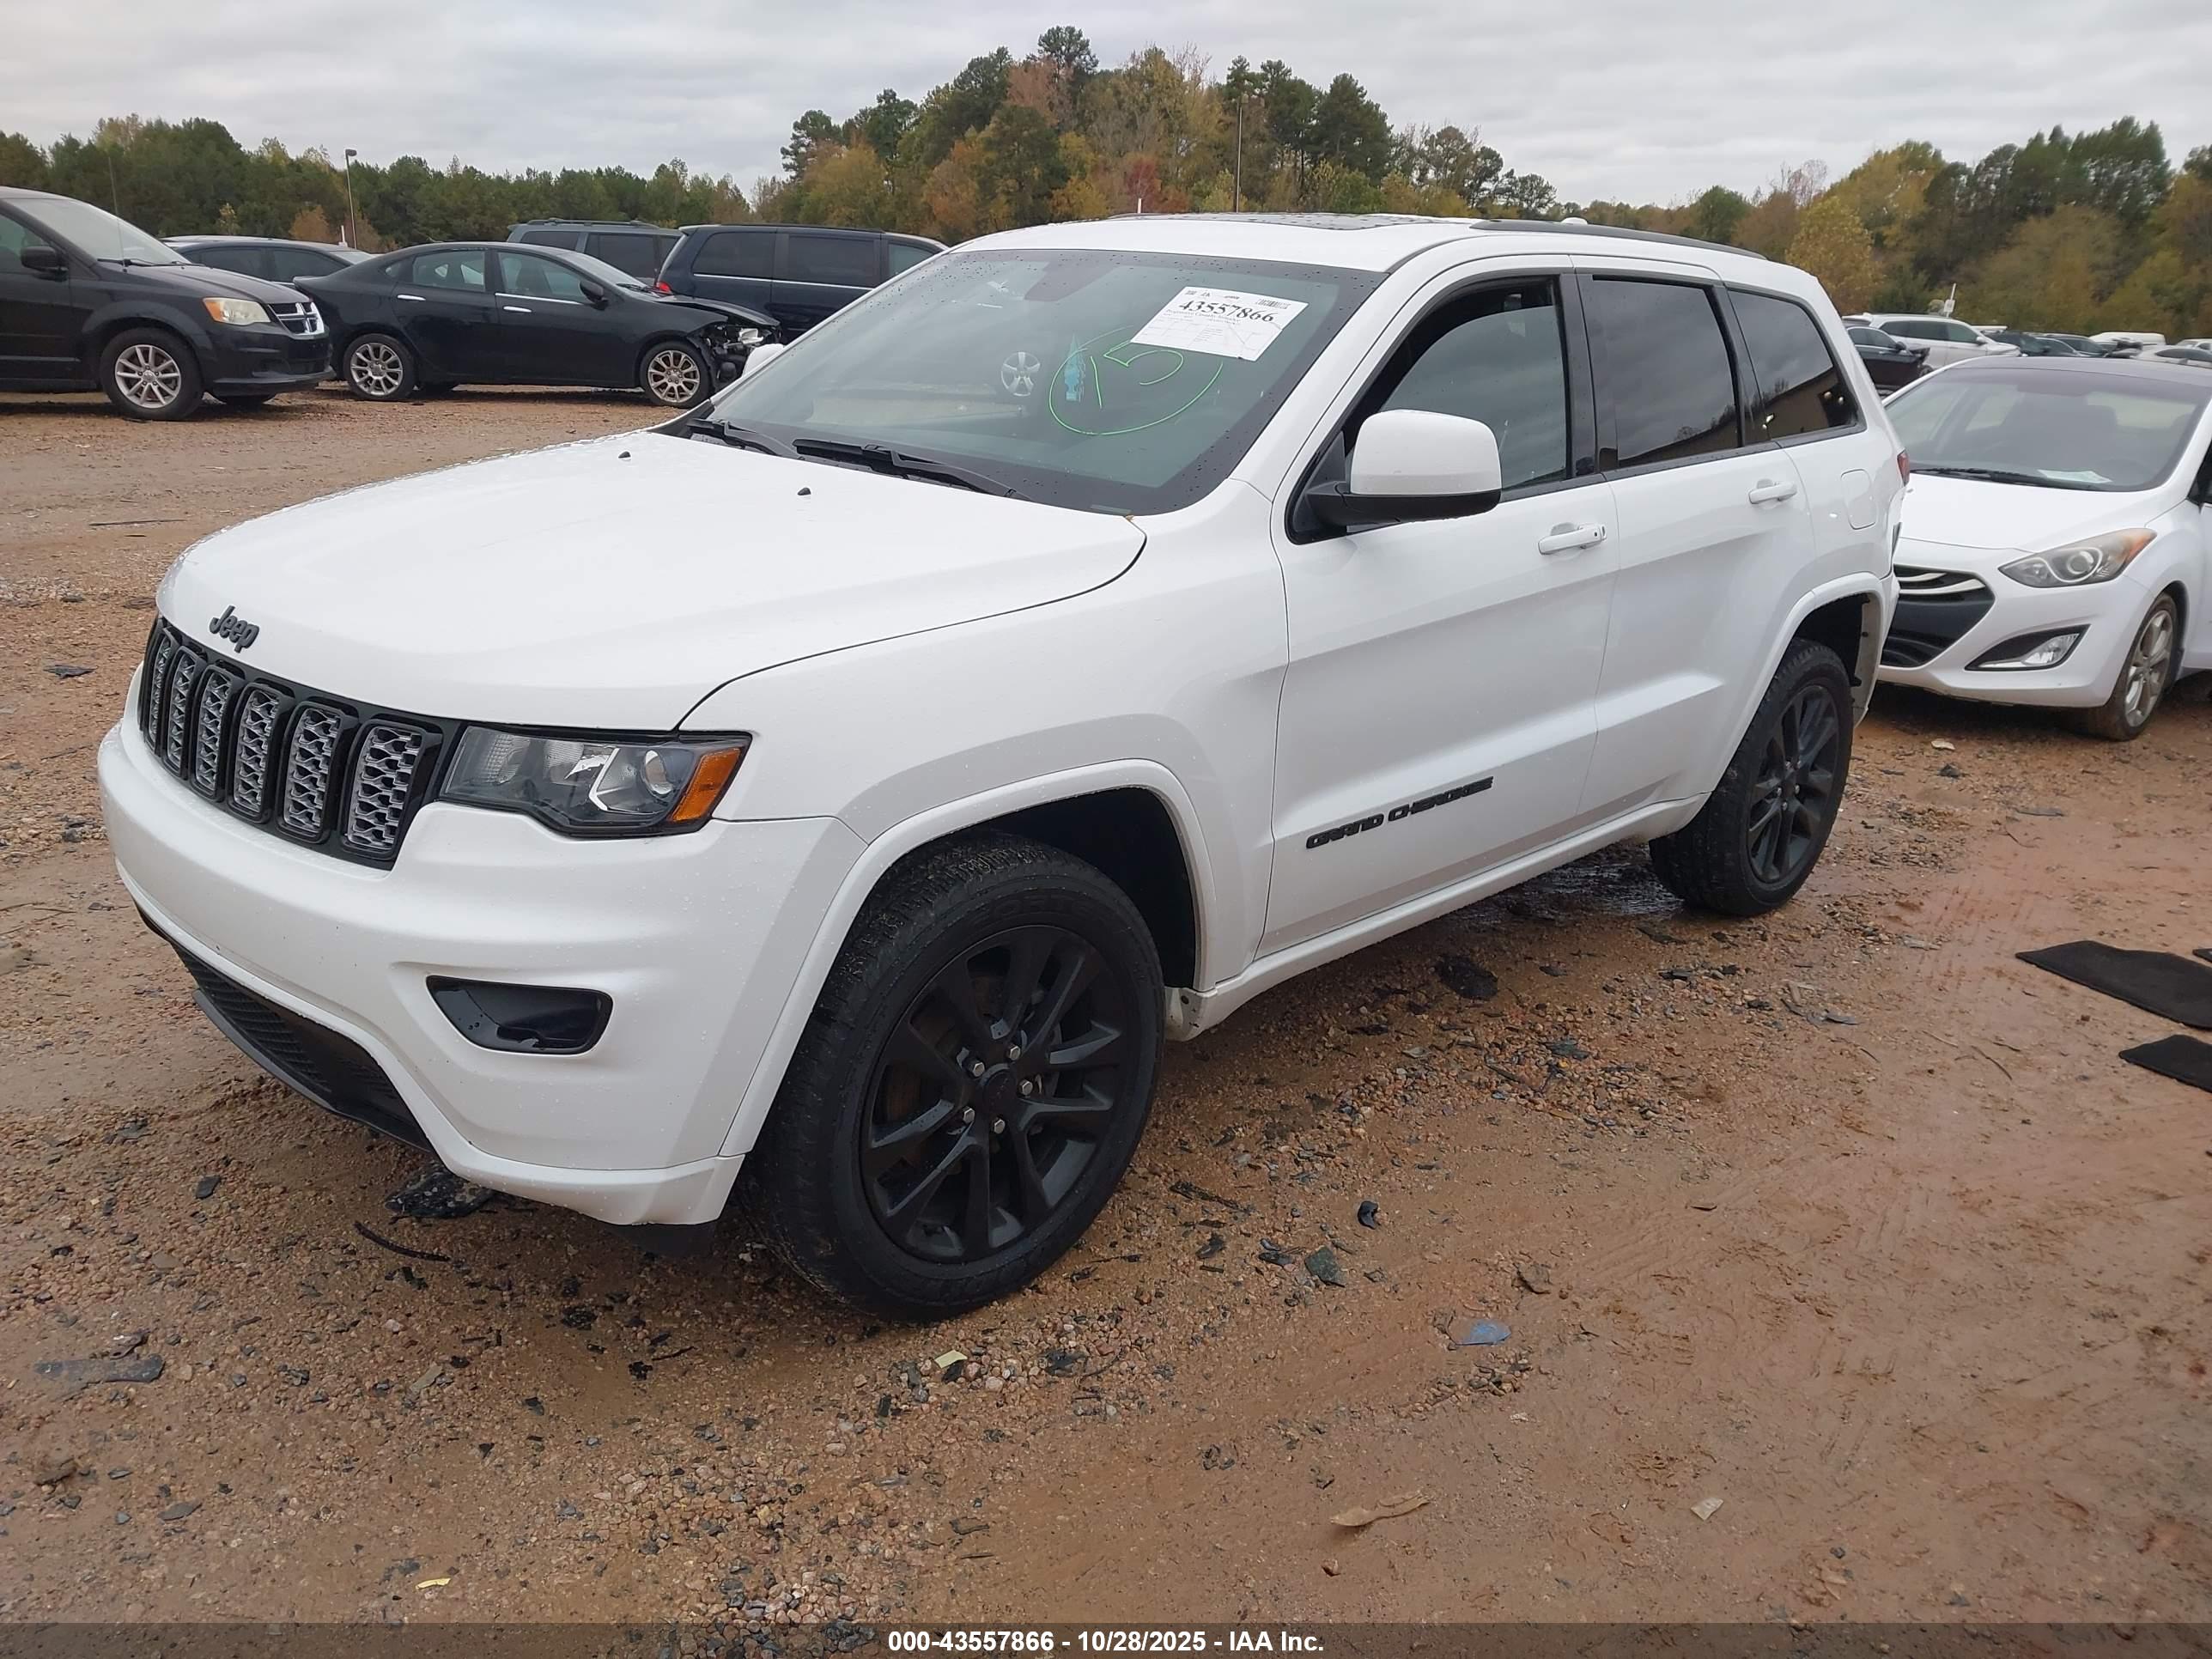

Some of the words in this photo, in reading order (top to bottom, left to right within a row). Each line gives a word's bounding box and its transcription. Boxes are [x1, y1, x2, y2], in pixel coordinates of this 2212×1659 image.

[1179, 300, 1278, 322] 43557866
[210, 605, 259, 653] Jeep
[1306, 812, 1384, 848] GRAND
[1389, 776, 1493, 822] CHEROKEE
